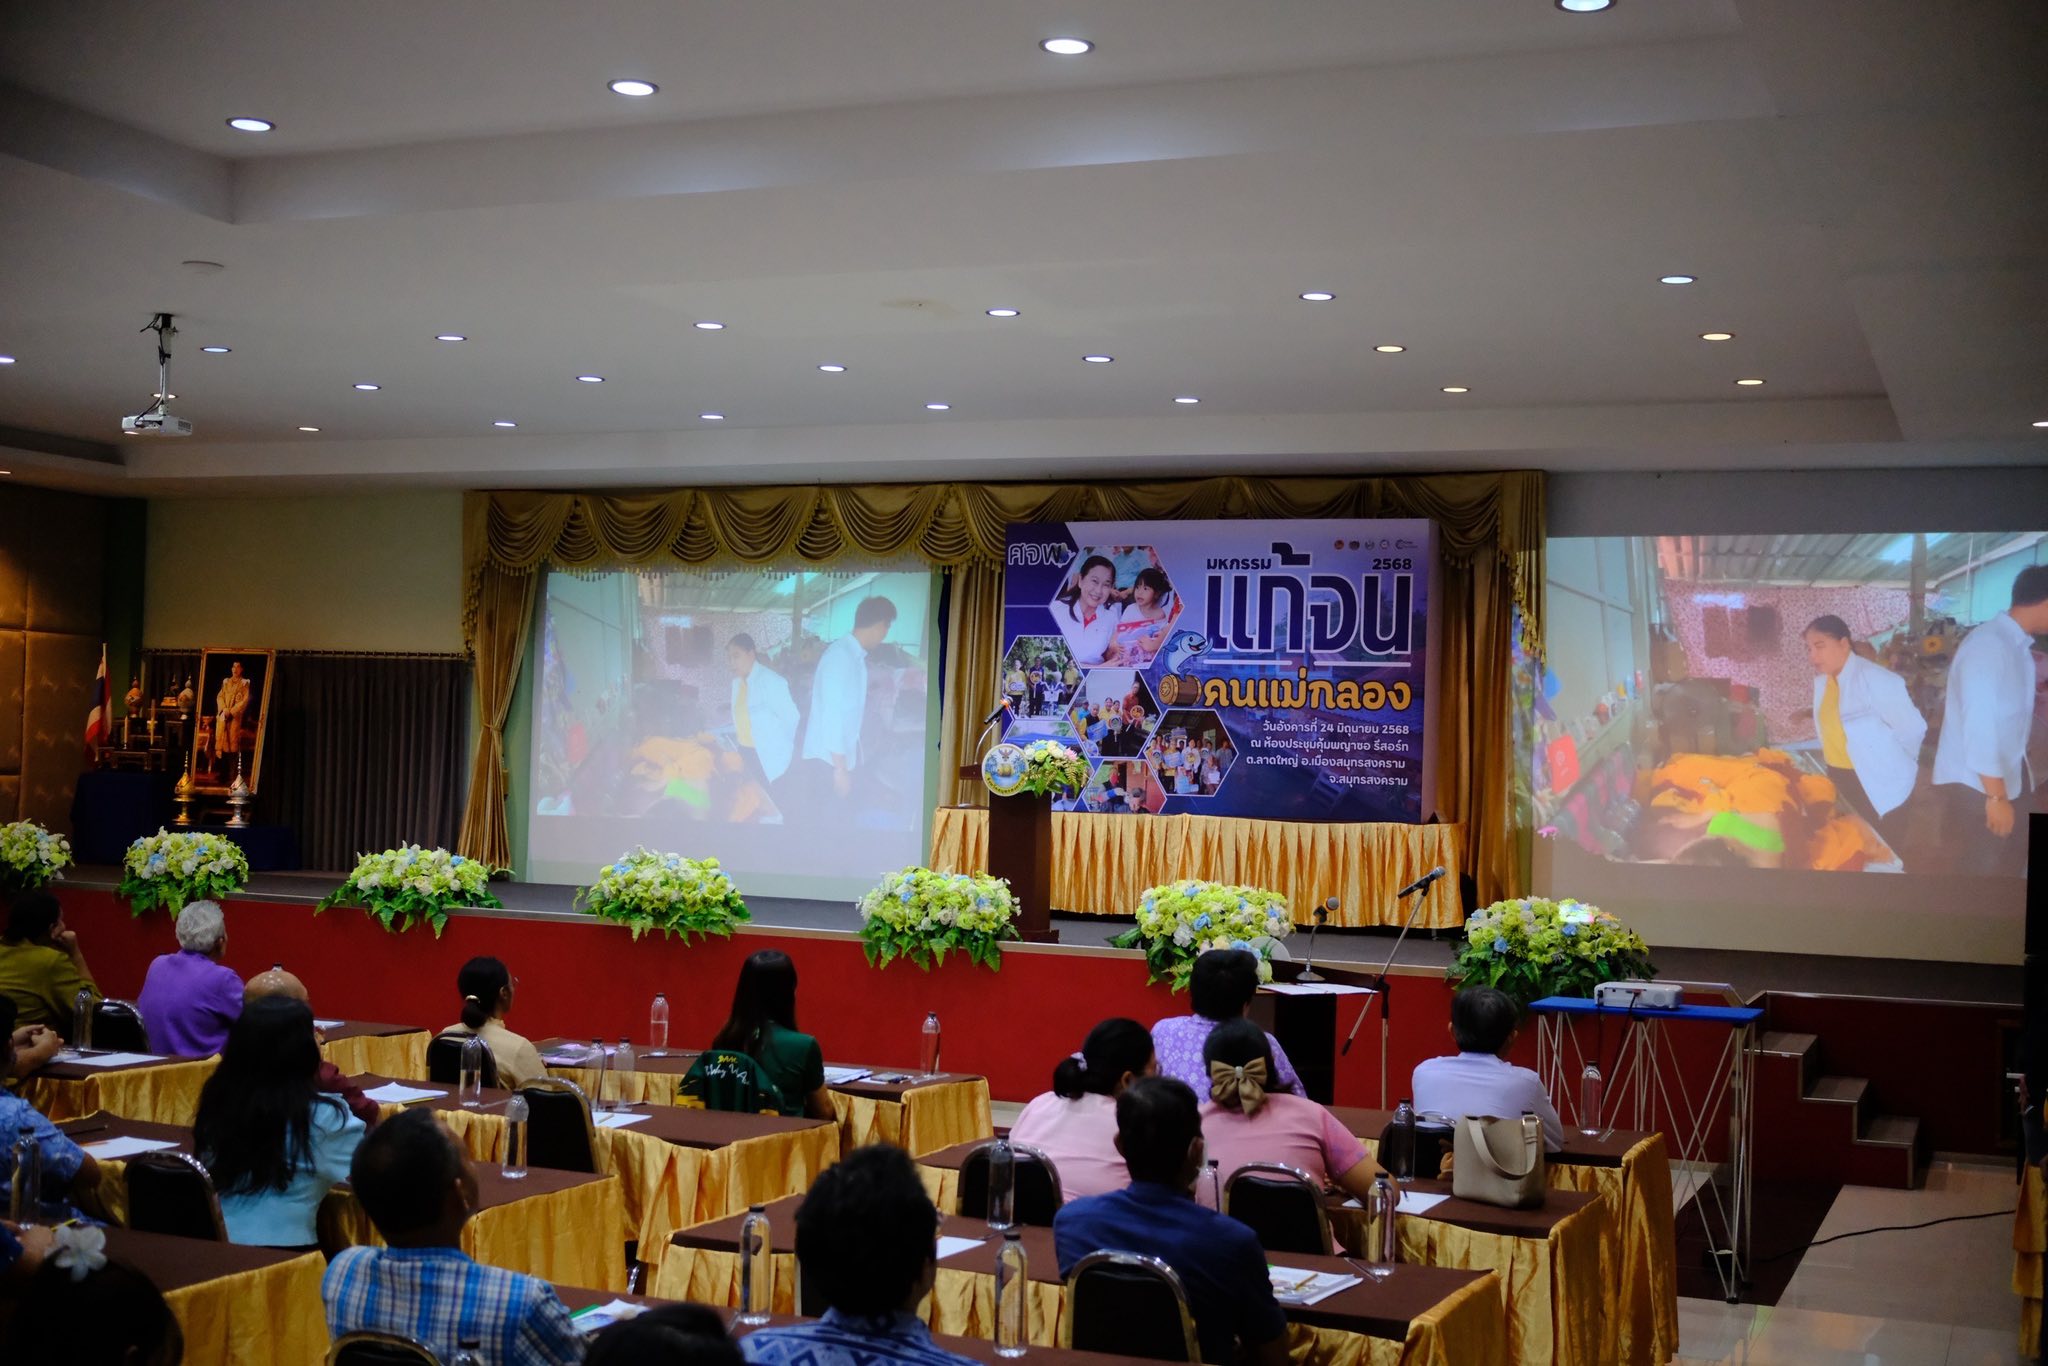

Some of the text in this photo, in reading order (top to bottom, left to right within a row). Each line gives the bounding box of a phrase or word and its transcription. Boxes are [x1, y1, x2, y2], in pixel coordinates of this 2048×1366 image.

[1206, 558, 1272, 570] มหกรรม
[1372, 558, 1412, 570] 2568
[1205, 542, 1413, 655] แก้จน
[1203, 666, 1413, 711] คนแม่กลอง
[1262, 717, 1409, 736] วันอังคารที่ 24 มิถุนายน 2568
[1250, 739, 1261, 748] ณ
[1373, 738, 1409, 752] รีสอร์ท
[1246, 754, 1405, 770] ต.ลาดใหญ่ อ.เมืองสมุทรสงคราม
[1329, 775, 1408, 787] จ.สมุทรสงคราม
